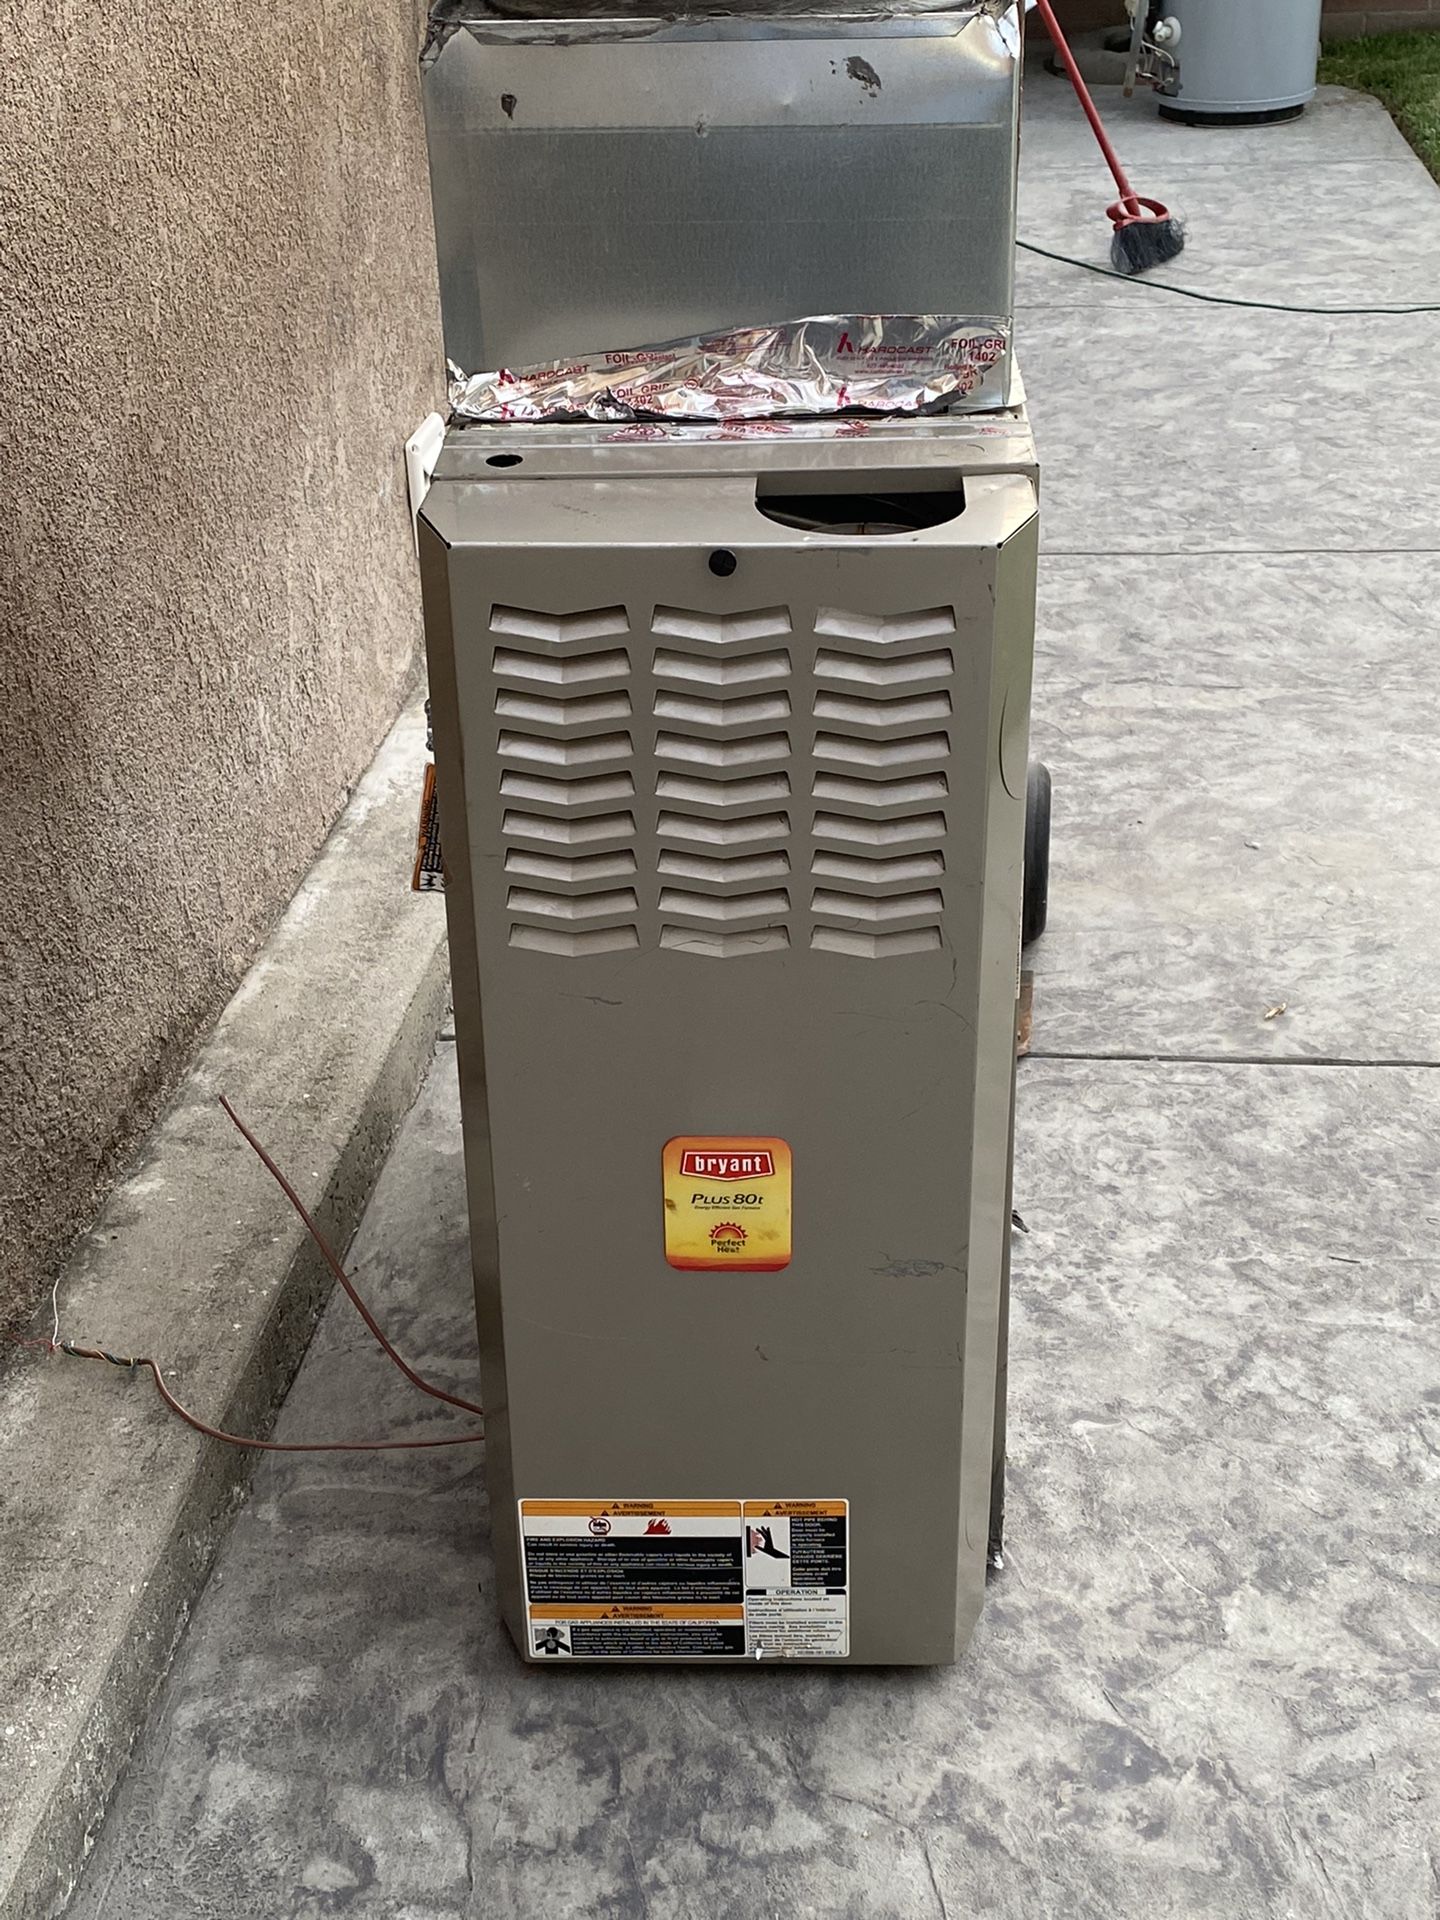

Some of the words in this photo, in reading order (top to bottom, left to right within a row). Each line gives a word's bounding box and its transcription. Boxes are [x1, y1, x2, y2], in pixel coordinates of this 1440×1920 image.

[857, 346, 934, 354] HARDCAST
[969, 351, 996, 361] 1402
[695, 1155, 762, 1175] bryant
[711, 1239, 746, 1247] Perfect
